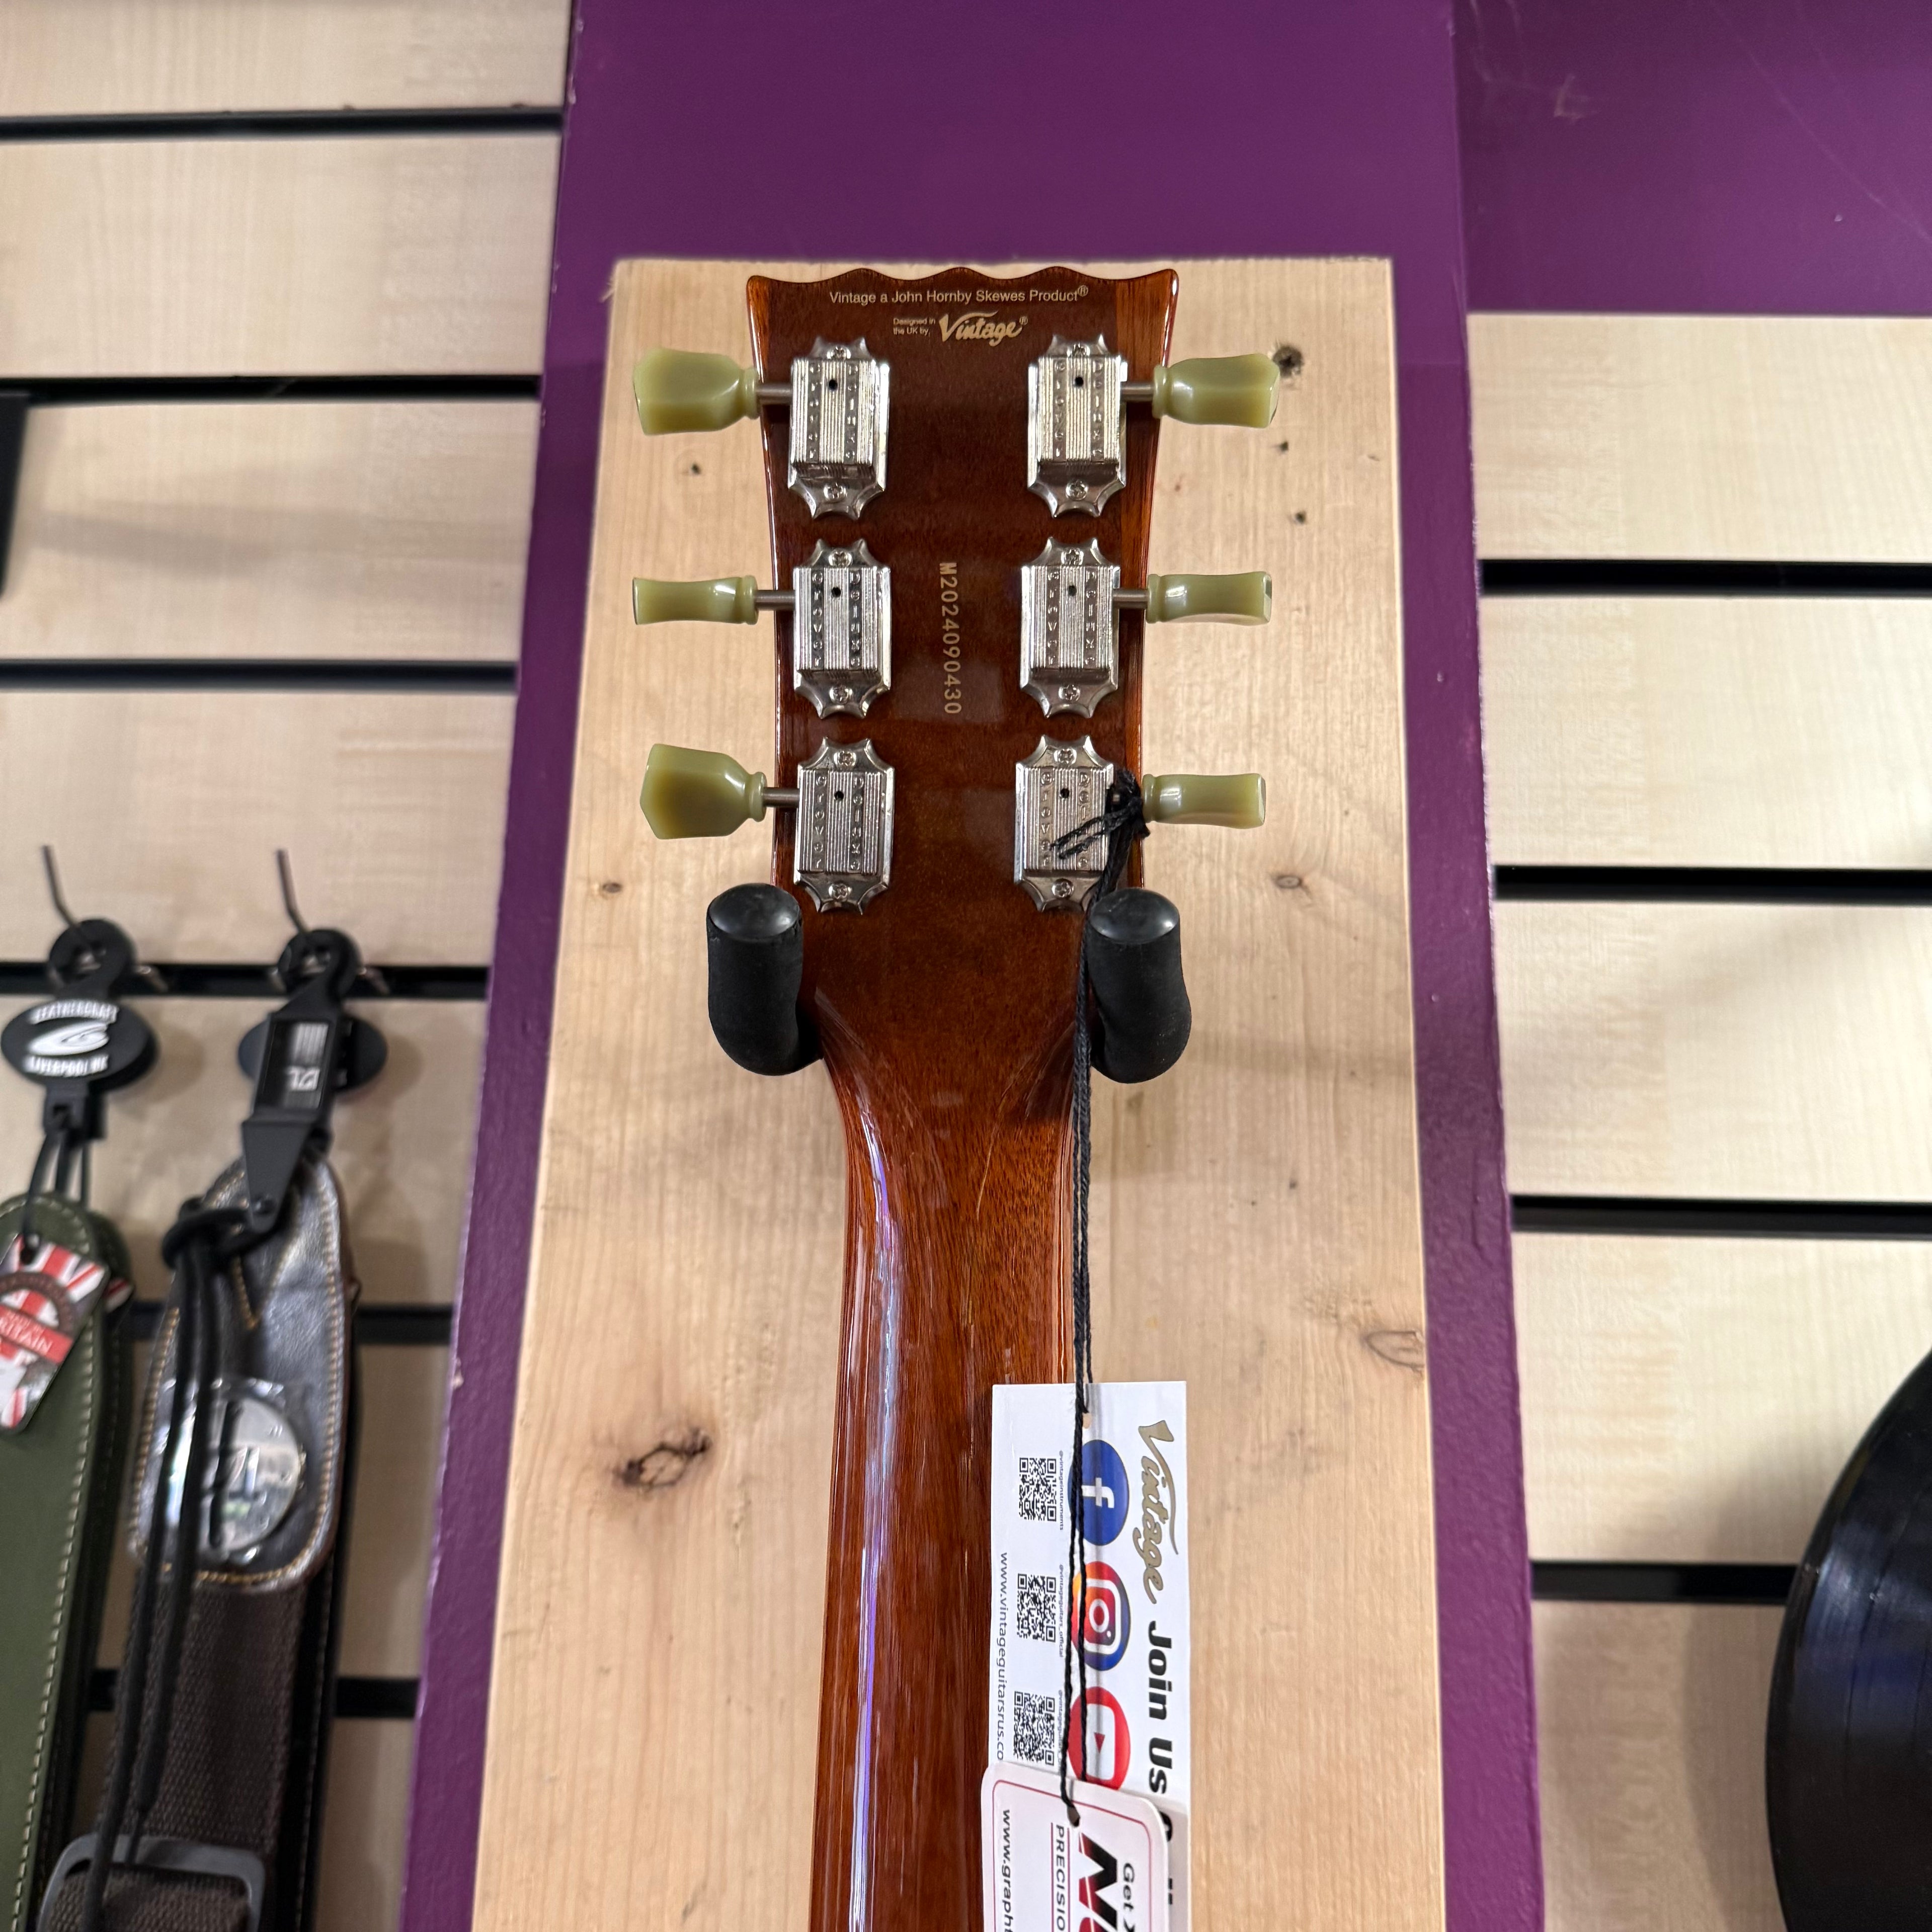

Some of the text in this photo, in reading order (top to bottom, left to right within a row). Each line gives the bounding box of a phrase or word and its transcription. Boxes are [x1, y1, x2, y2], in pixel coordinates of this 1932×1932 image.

[830, 291, 875, 306] Vintage
[880, 294, 888, 303] a
[892, 291, 922, 303] John
[927, 290, 972, 304] Hornby
[976, 290, 1025, 302] Skewes
[907, 327, 918, 335] UK
[939, 562, 962, 714] M2024090430
[1133, 1420, 1179, 1604] Vintage
[997, 1552, 1009, 1761] www.vintageguitarsrus.co
[1149, 1621, 1172, 1720] Join
[1149, 1737, 1173, 1794] Us
[1122, 1863, 1135, 1911] Get
